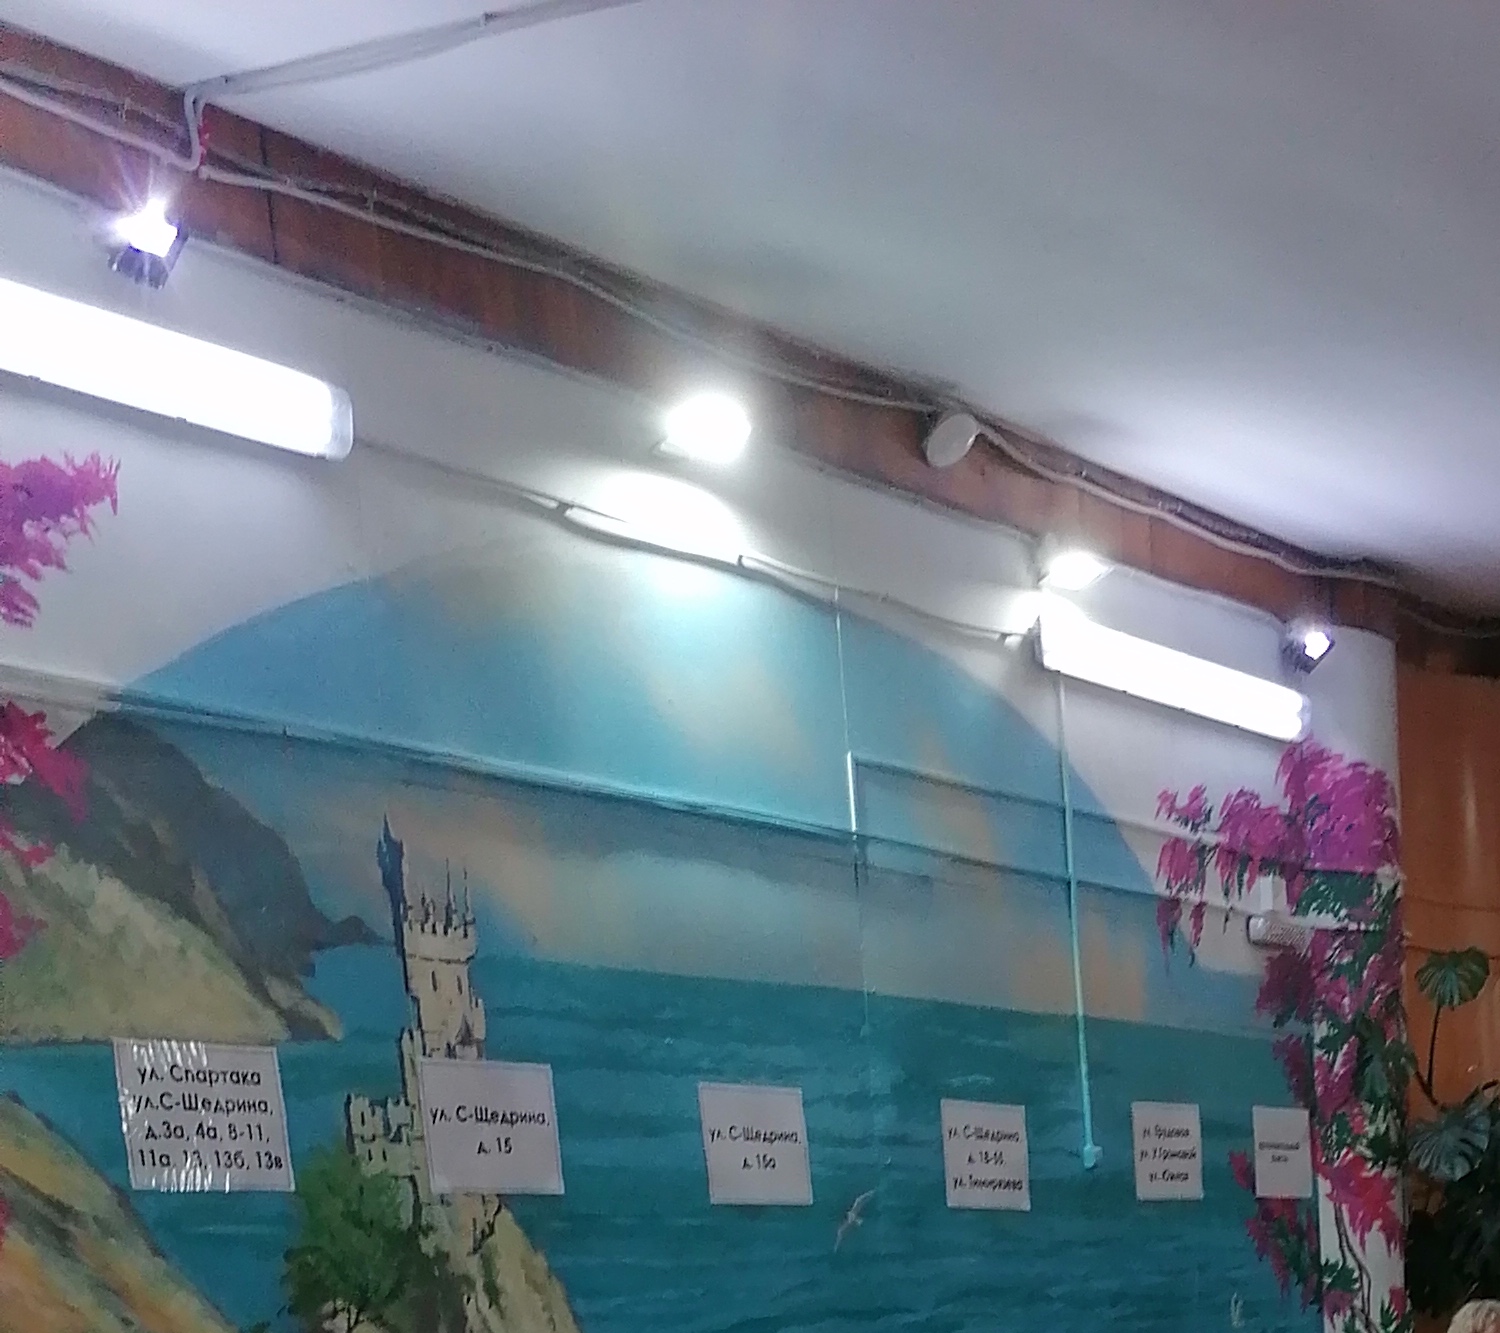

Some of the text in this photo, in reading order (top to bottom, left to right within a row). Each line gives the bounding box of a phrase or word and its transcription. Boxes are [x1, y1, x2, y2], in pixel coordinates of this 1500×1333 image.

[137, 1064, 261, 1087] ул. Спартака
[430, 1107, 451, 1125] ул.
[496, 1137, 512, 1154] 15
[256, 1151, 283, 1170] 13в
